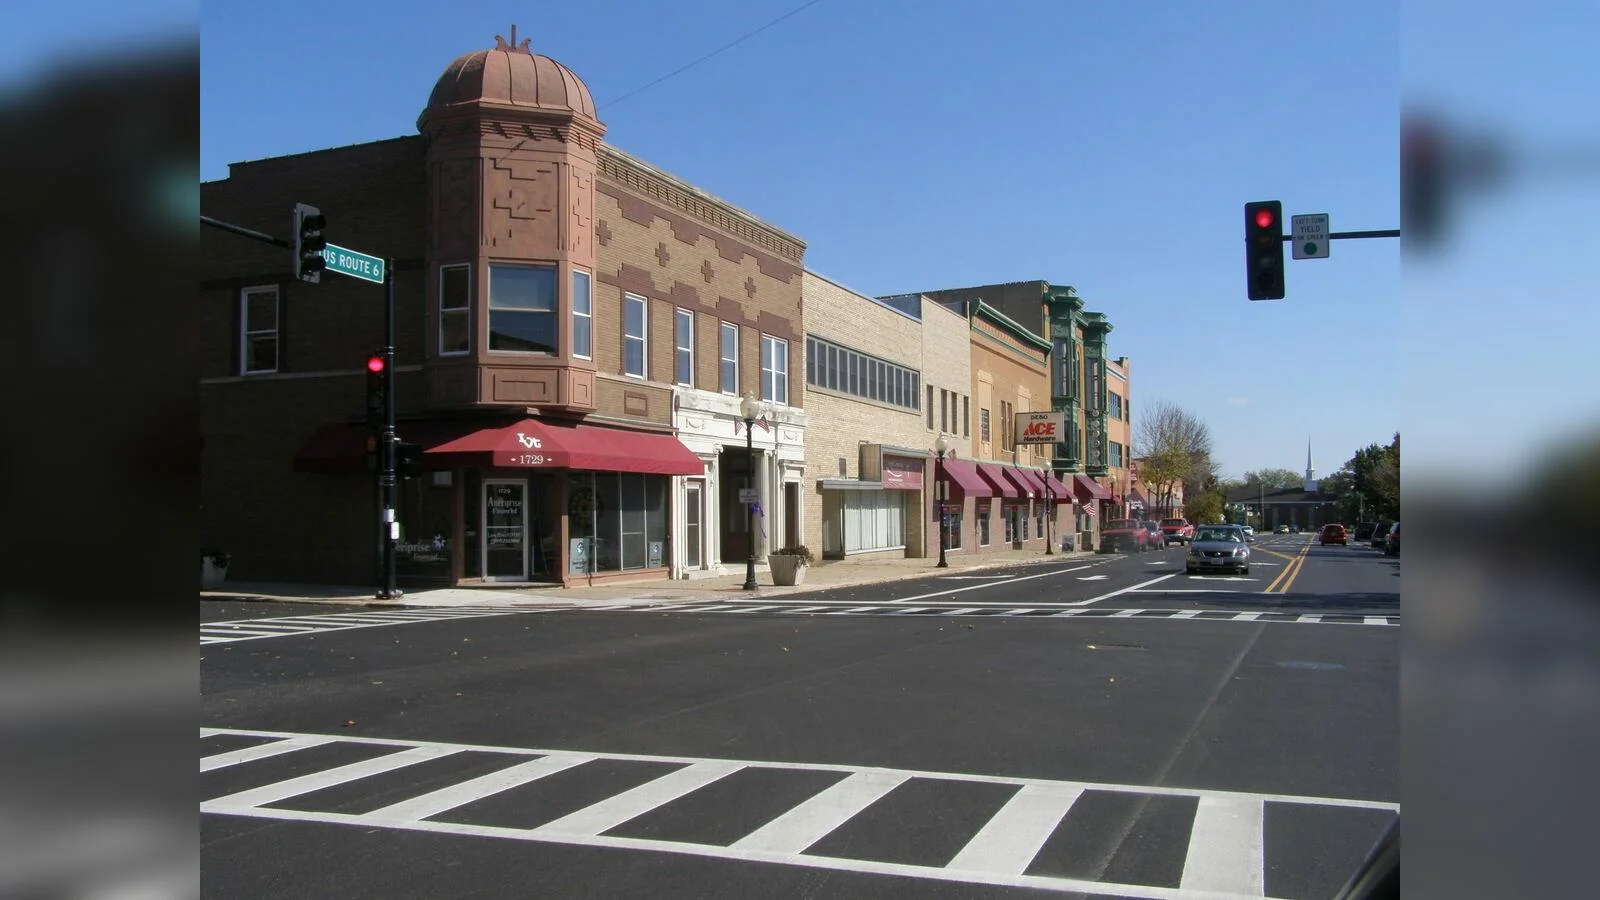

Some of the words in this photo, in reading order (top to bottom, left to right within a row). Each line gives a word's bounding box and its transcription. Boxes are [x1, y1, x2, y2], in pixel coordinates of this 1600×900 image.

[323, 250, 336, 264] US
[339, 255, 370, 273] ROUTE
[373, 265, 379, 276] 6
[1023, 422, 1056, 435] ACE
[519, 454, 544, 465] 1729
[394, 541, 430, 554] eriprise
